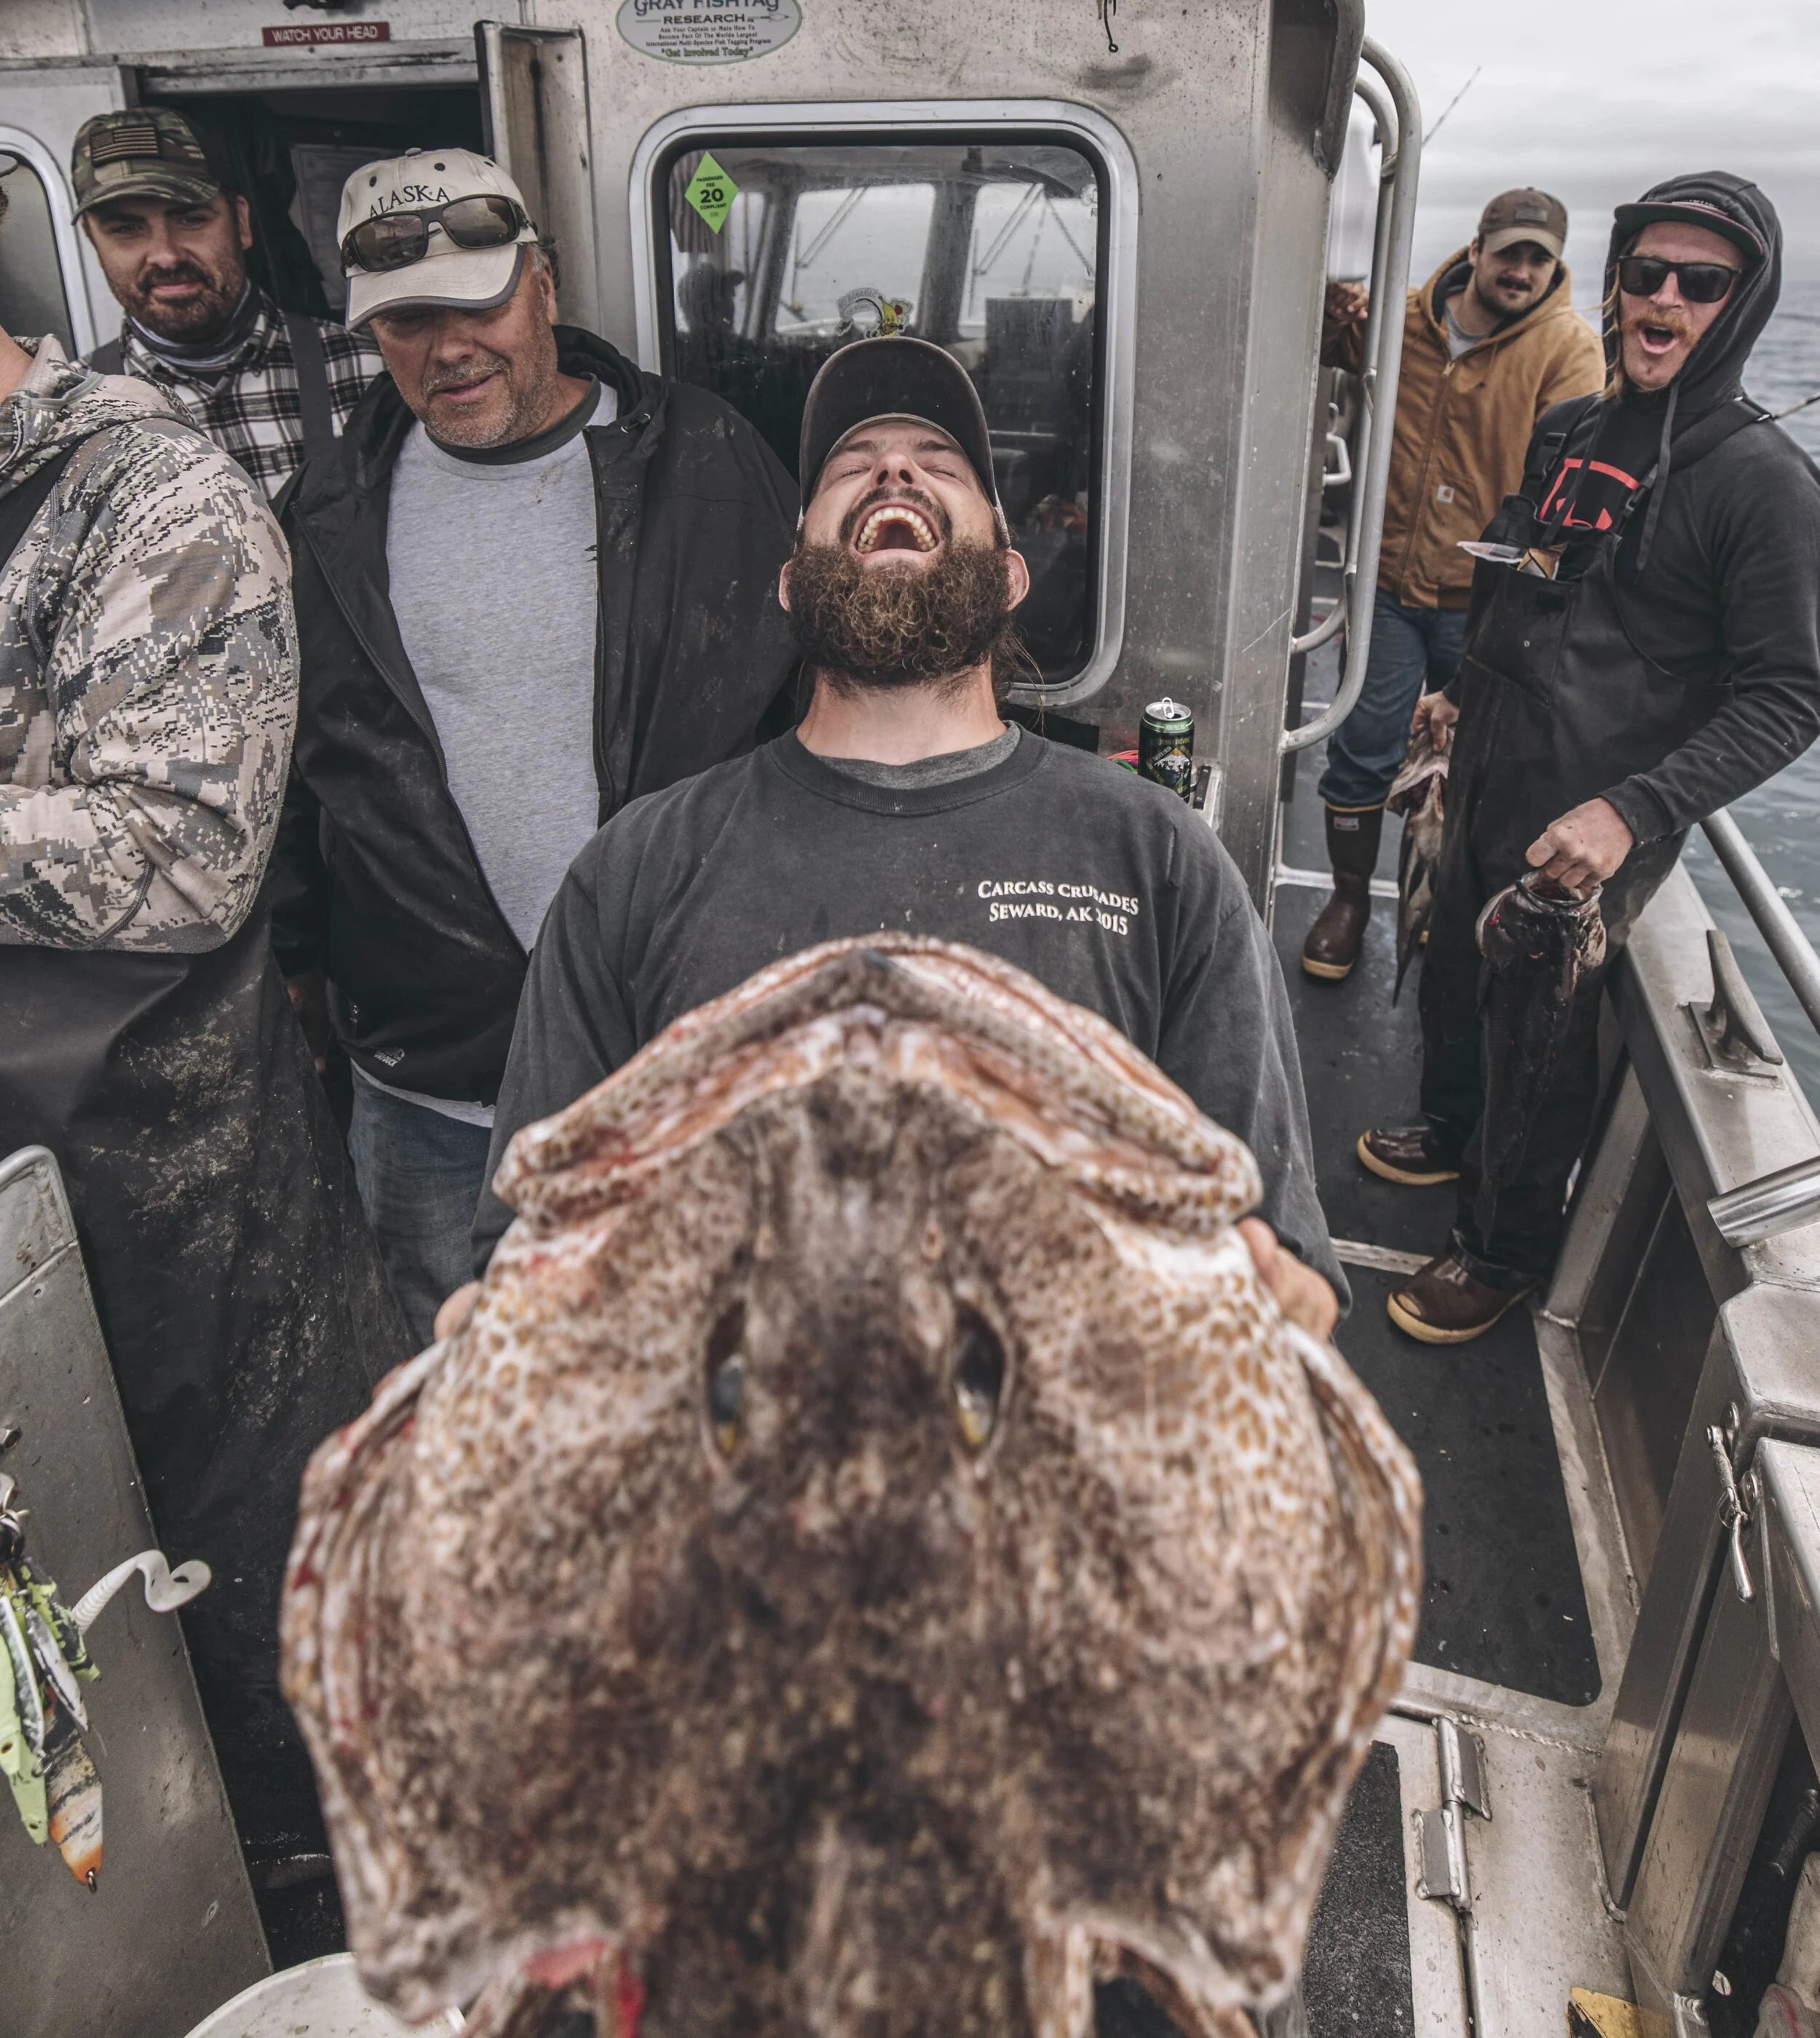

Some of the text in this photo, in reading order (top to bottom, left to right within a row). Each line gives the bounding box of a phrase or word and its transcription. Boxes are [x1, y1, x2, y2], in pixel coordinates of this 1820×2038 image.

[663, 14, 745, 24] RESEARCH
[272, 25, 379, 42] WATCH YOUR HEAD
[684, 47, 719, 57] Involved
[370, 185, 451, 218] ALASKA
[700, 188, 724, 203] 20
[978, 880, 1139, 915] CARCASS CRUSADES
[989, 902, 1063, 922] SEWARD,
[1066, 906, 1093, 922] AK
